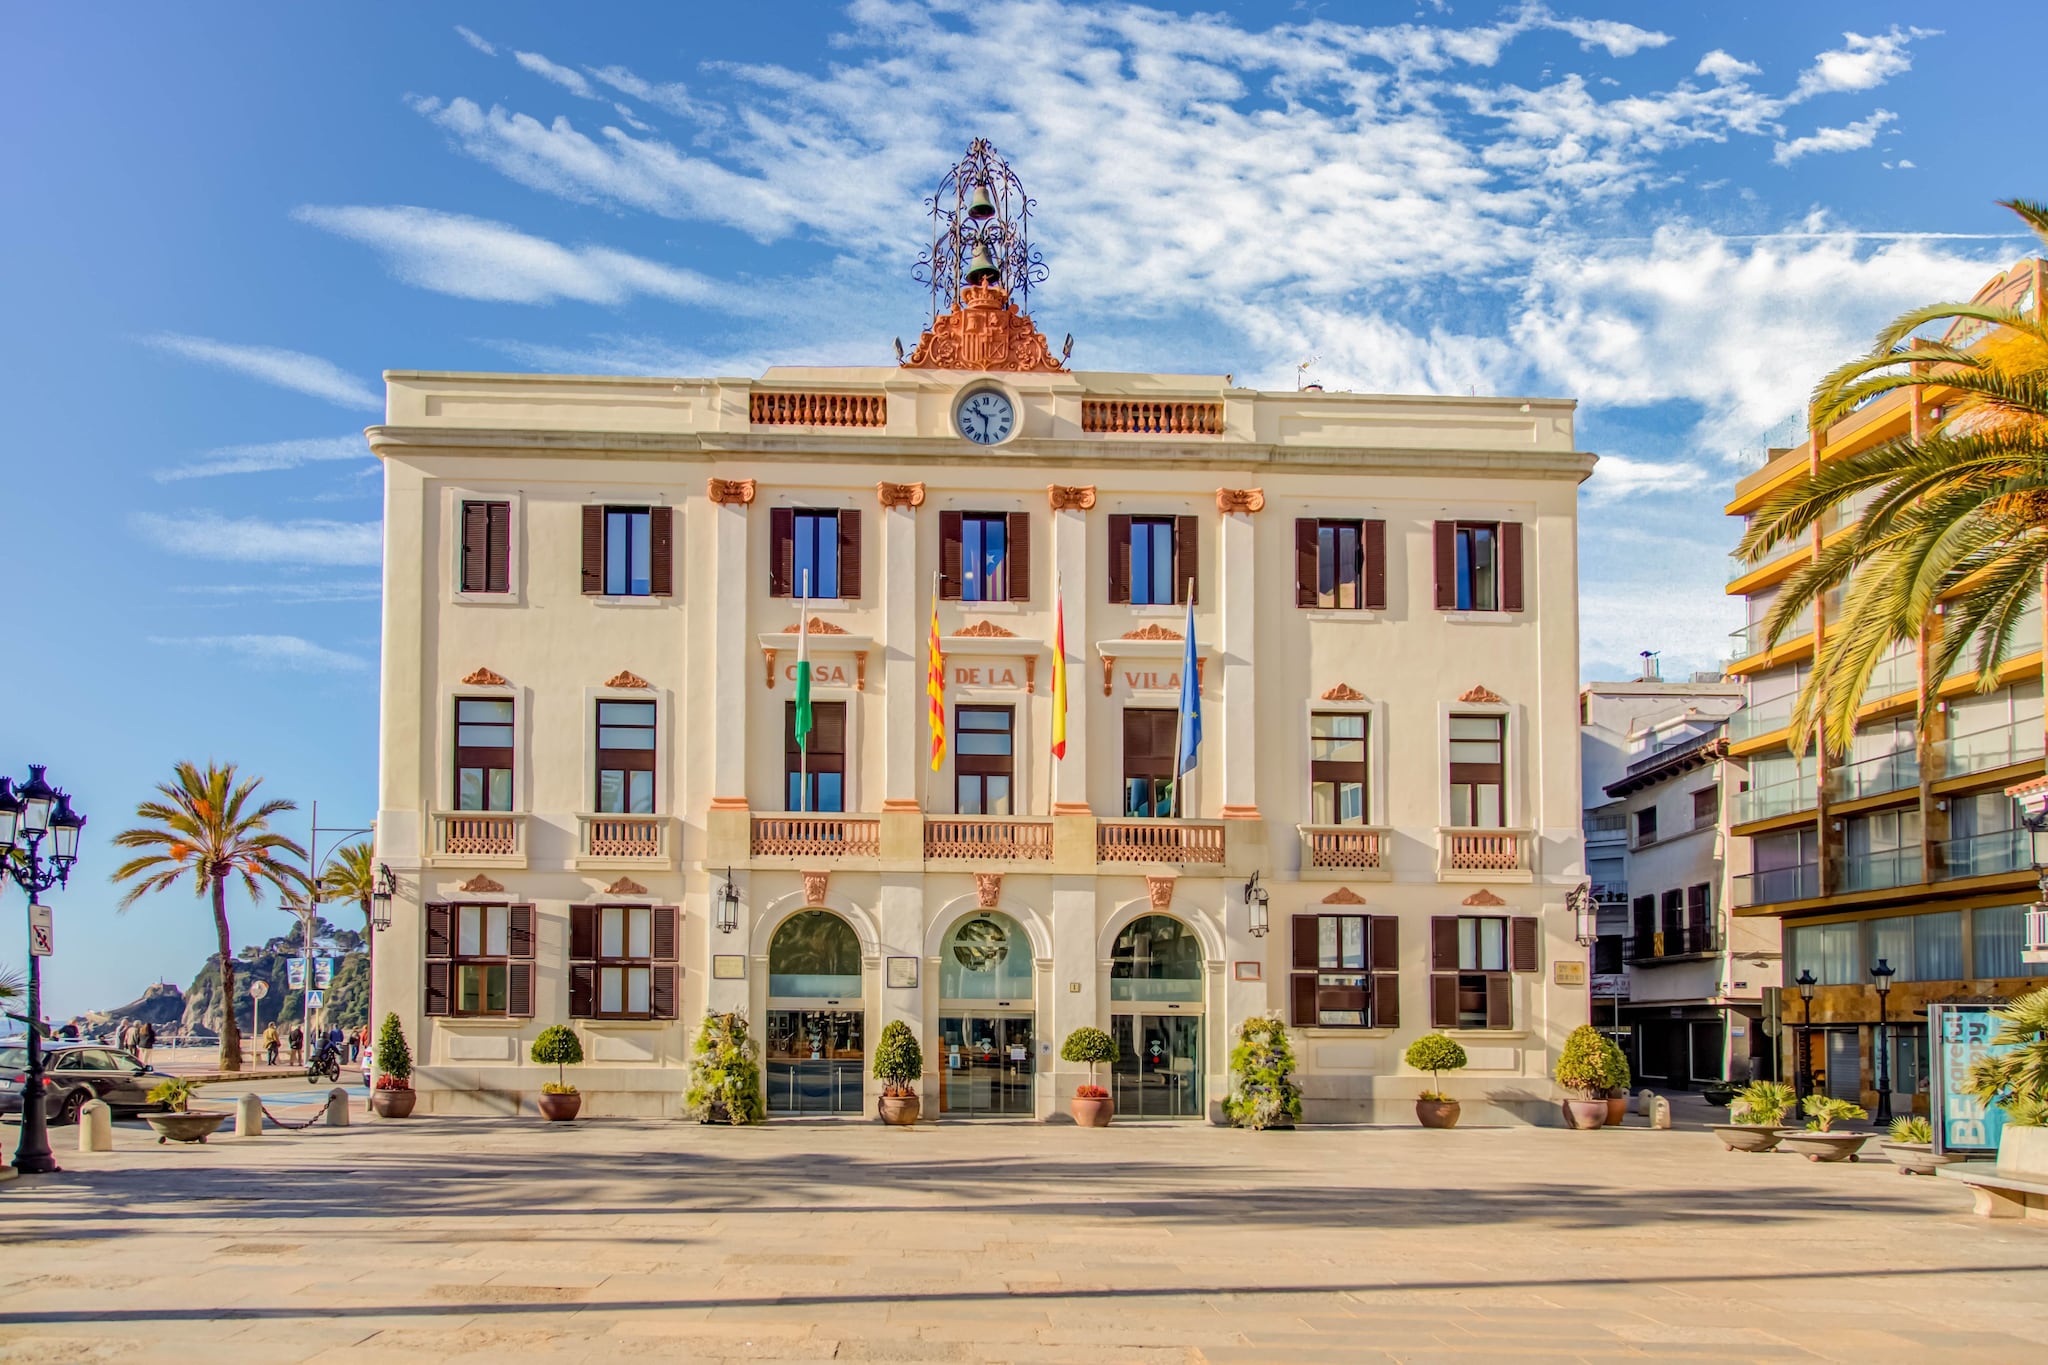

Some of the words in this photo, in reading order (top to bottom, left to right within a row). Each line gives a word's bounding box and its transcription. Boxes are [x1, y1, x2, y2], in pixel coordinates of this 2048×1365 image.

[785, 664, 846, 683] CSA
[955, 667, 981, 684] DE
[988, 668, 1015, 685] LA
[1125, 671, 1181, 689] VILA
[1945, 1015, 1964, 1094] careful
[1950, 1098, 1986, 1145] BE
